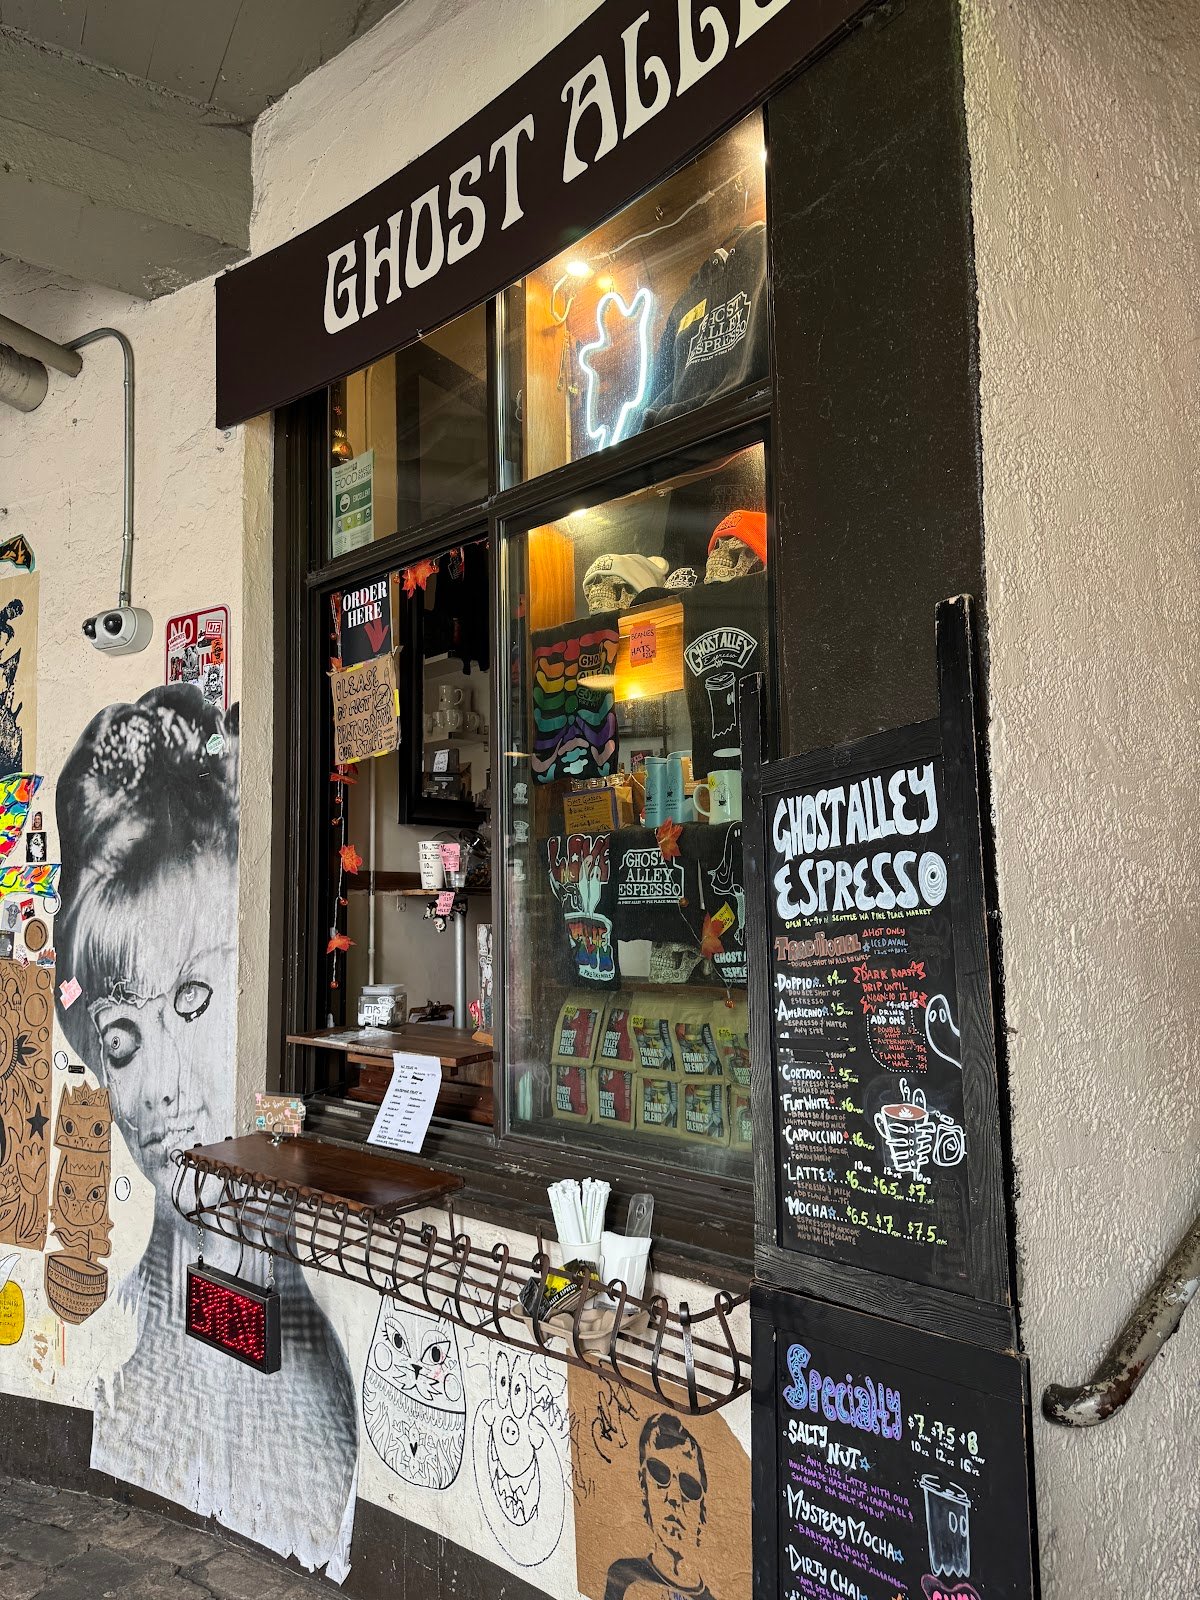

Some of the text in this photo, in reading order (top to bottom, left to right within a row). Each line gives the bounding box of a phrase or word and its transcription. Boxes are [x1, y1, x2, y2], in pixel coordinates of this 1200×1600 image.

[323, 114, 534, 335] GHOST
[342, 580, 387, 612] ORDER
[347, 601, 382, 629] HERE
[631, 645, 650, 656] HATS
[689, 632, 753, 673] GHOST ALLEY
[336, 666, 379, 701] PLEASE
[349, 695, 371, 716] NOT
[356, 730, 382, 757] STUFF
[773, 762, 938, 861] GHOST ALLEY
[625, 852, 665, 868] GHOST
[626, 868, 674, 882] ALLEY
[774, 851, 947, 920] ESPRESSO
[619, 883, 682, 896] ESPRESSO
[832, 913, 857, 922] SEATTLE
[906, 908, 932, 917] MARKET
[886, 928, 905, 936] ONLY
[887, 938, 908, 947] AVAIL
[714, 951, 742, 963] GHOST
[777, 973, 812, 992] DOPPIO
[861, 968, 917, 981] DARK ROAST
[862, 982, 908, 992] DRIP UNTIL
[777, 998, 822, 1021] AMERICANO
[870, 1015, 906, 1025] ADD ONS
[826, 1020, 847, 1029] WATER
[782, 1064, 821, 1080] CORTADO
[785, 1125, 843, 1145] CAPPUCCINO
[788, 1163, 827, 1182] LATTE
[788, 1196, 828, 1219] MOCHA
[908, 1221, 937, 1242] $7.5
[782, 1344, 903, 1440] Specialty
[788, 1418, 827, 1448] SALTY
[959, 1431, 978, 1455] $8
[827, 1443, 861, 1470] NUT
[788, 1458, 827, 1482] HOUSEMADE
[806, 1455, 910, 1507] ANY SIZE LATTE WITH OUR
[791, 1471, 821, 1490] SMOKED
[838, 1492, 856, 1505] SALT
[787, 1484, 896, 1562] MYSTERY MOCHA
[788, 1544, 860, 1600] DIRTY CHAI
